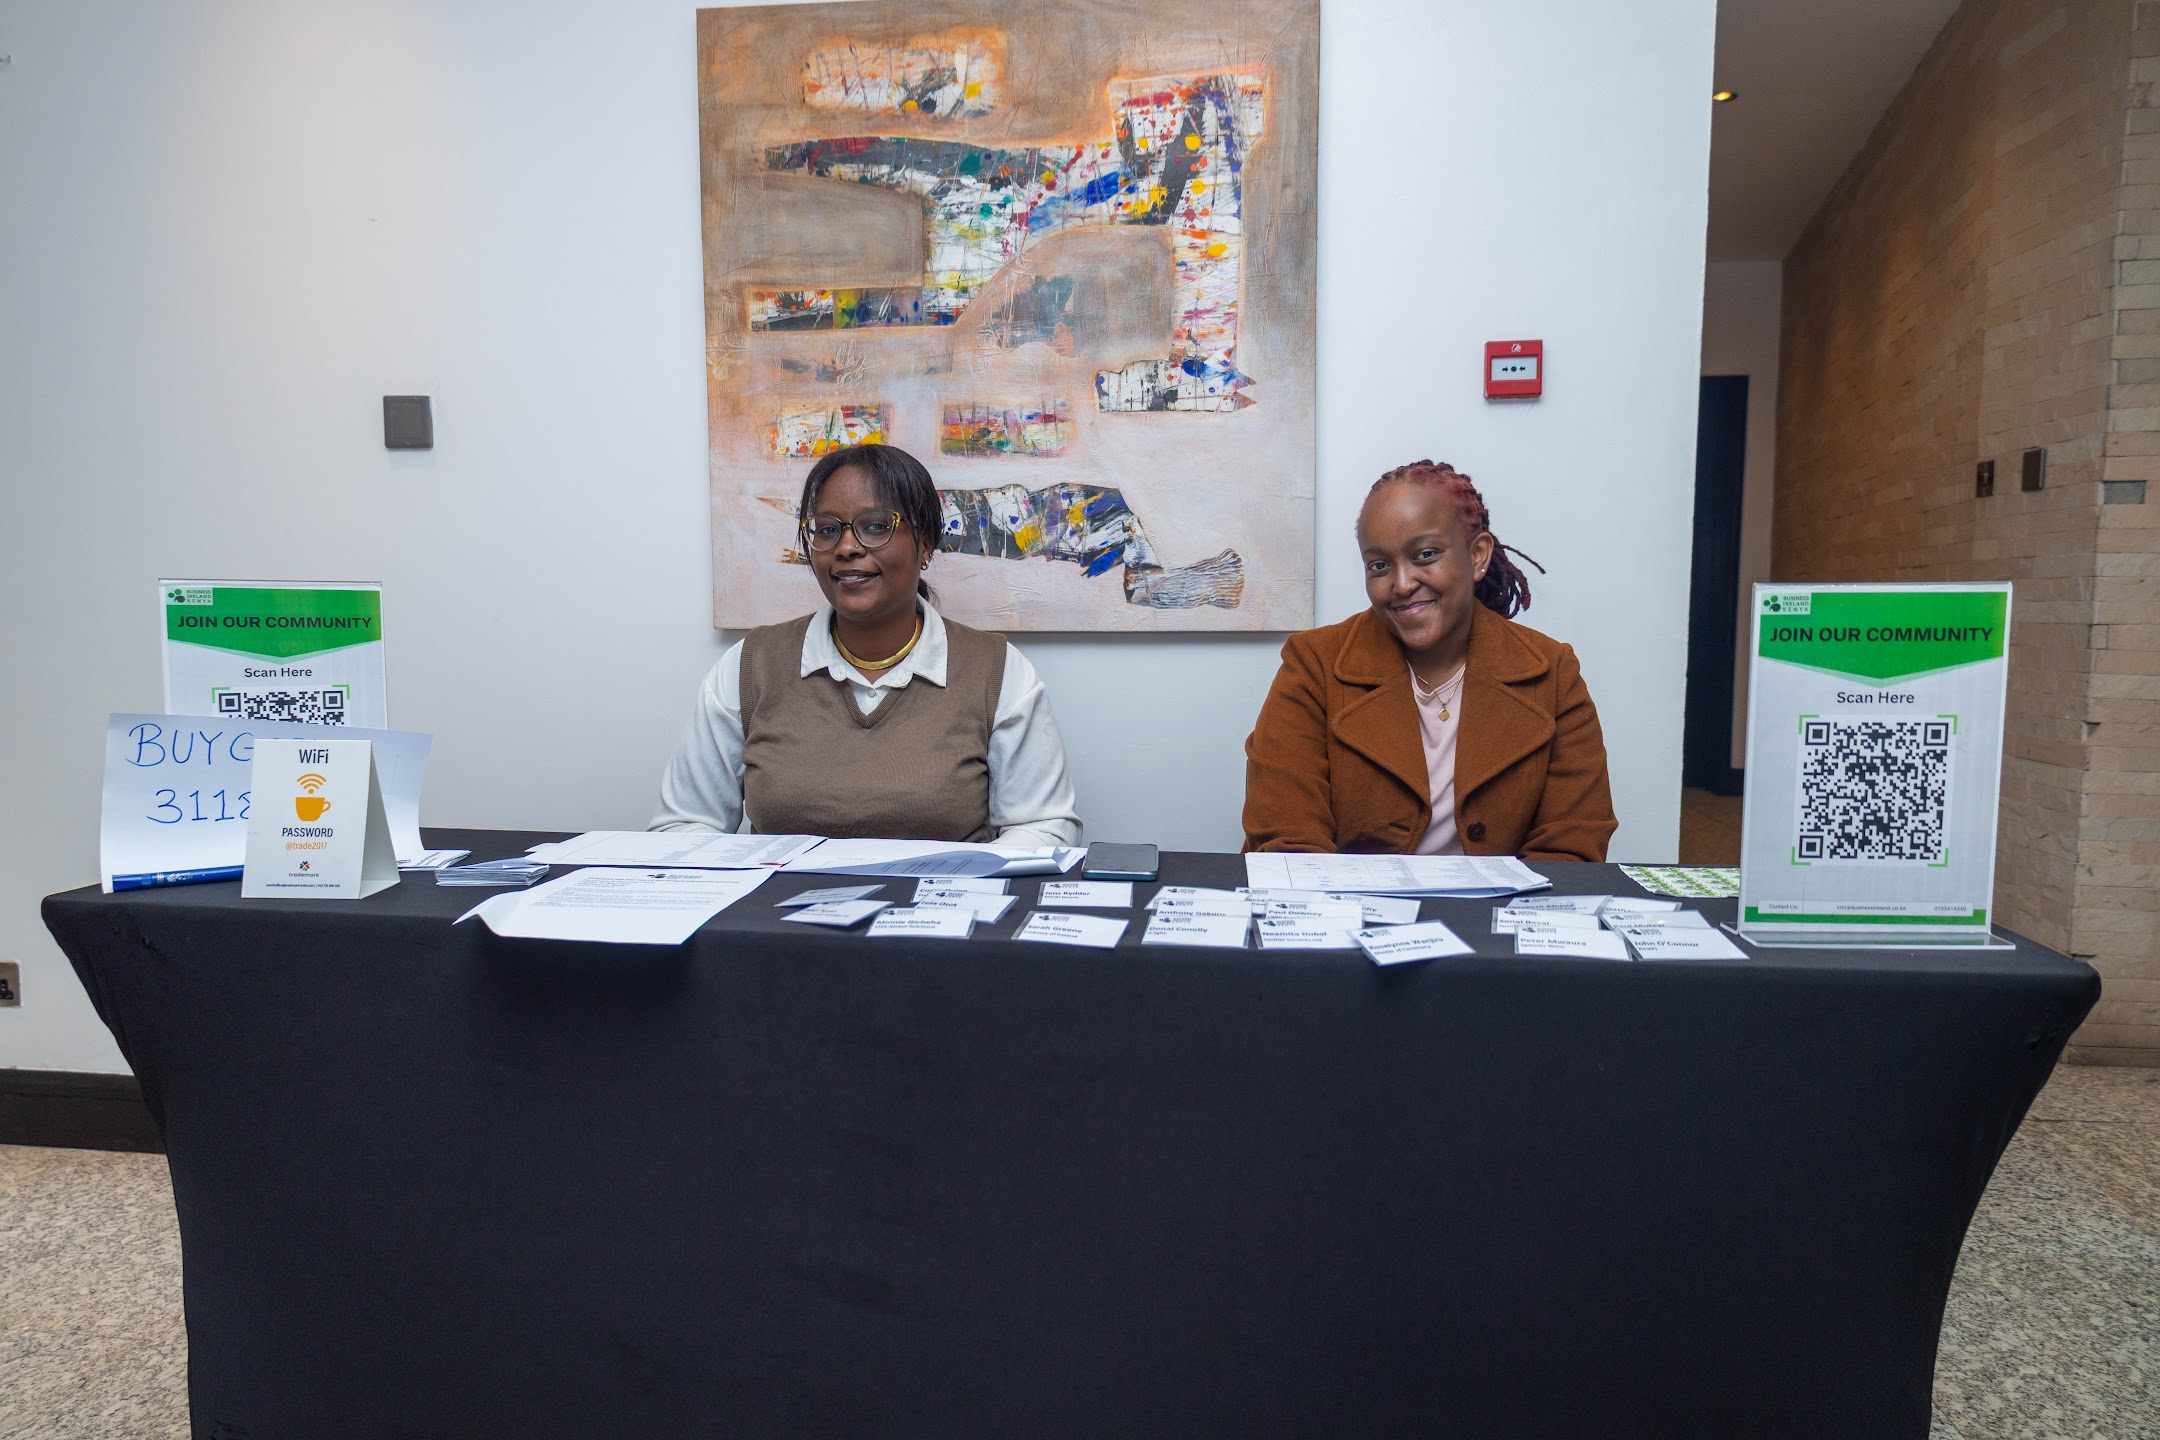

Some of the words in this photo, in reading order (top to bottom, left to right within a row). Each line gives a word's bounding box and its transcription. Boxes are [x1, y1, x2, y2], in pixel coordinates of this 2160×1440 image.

[177, 616, 218, 628] JOIN
[222, 616, 261, 628] OUR
[265, 616, 372, 629] COMMUNITY
[1769, 627, 1813, 642] JOIN
[1818, 627, 1861, 642] OUR
[1866, 627, 1994, 642] COMMUNITY
[244, 667, 277, 678] Scan
[281, 667, 313, 677] Here
[1836, 691, 1873, 704] Scan
[1878, 691, 1915, 704] Here
[298, 748, 329, 764] WiFi
[281, 827, 334, 838] PASSWORD
[285, 841, 328, 851] @trade2017
[1052, 925, 1083, 934] Greene
